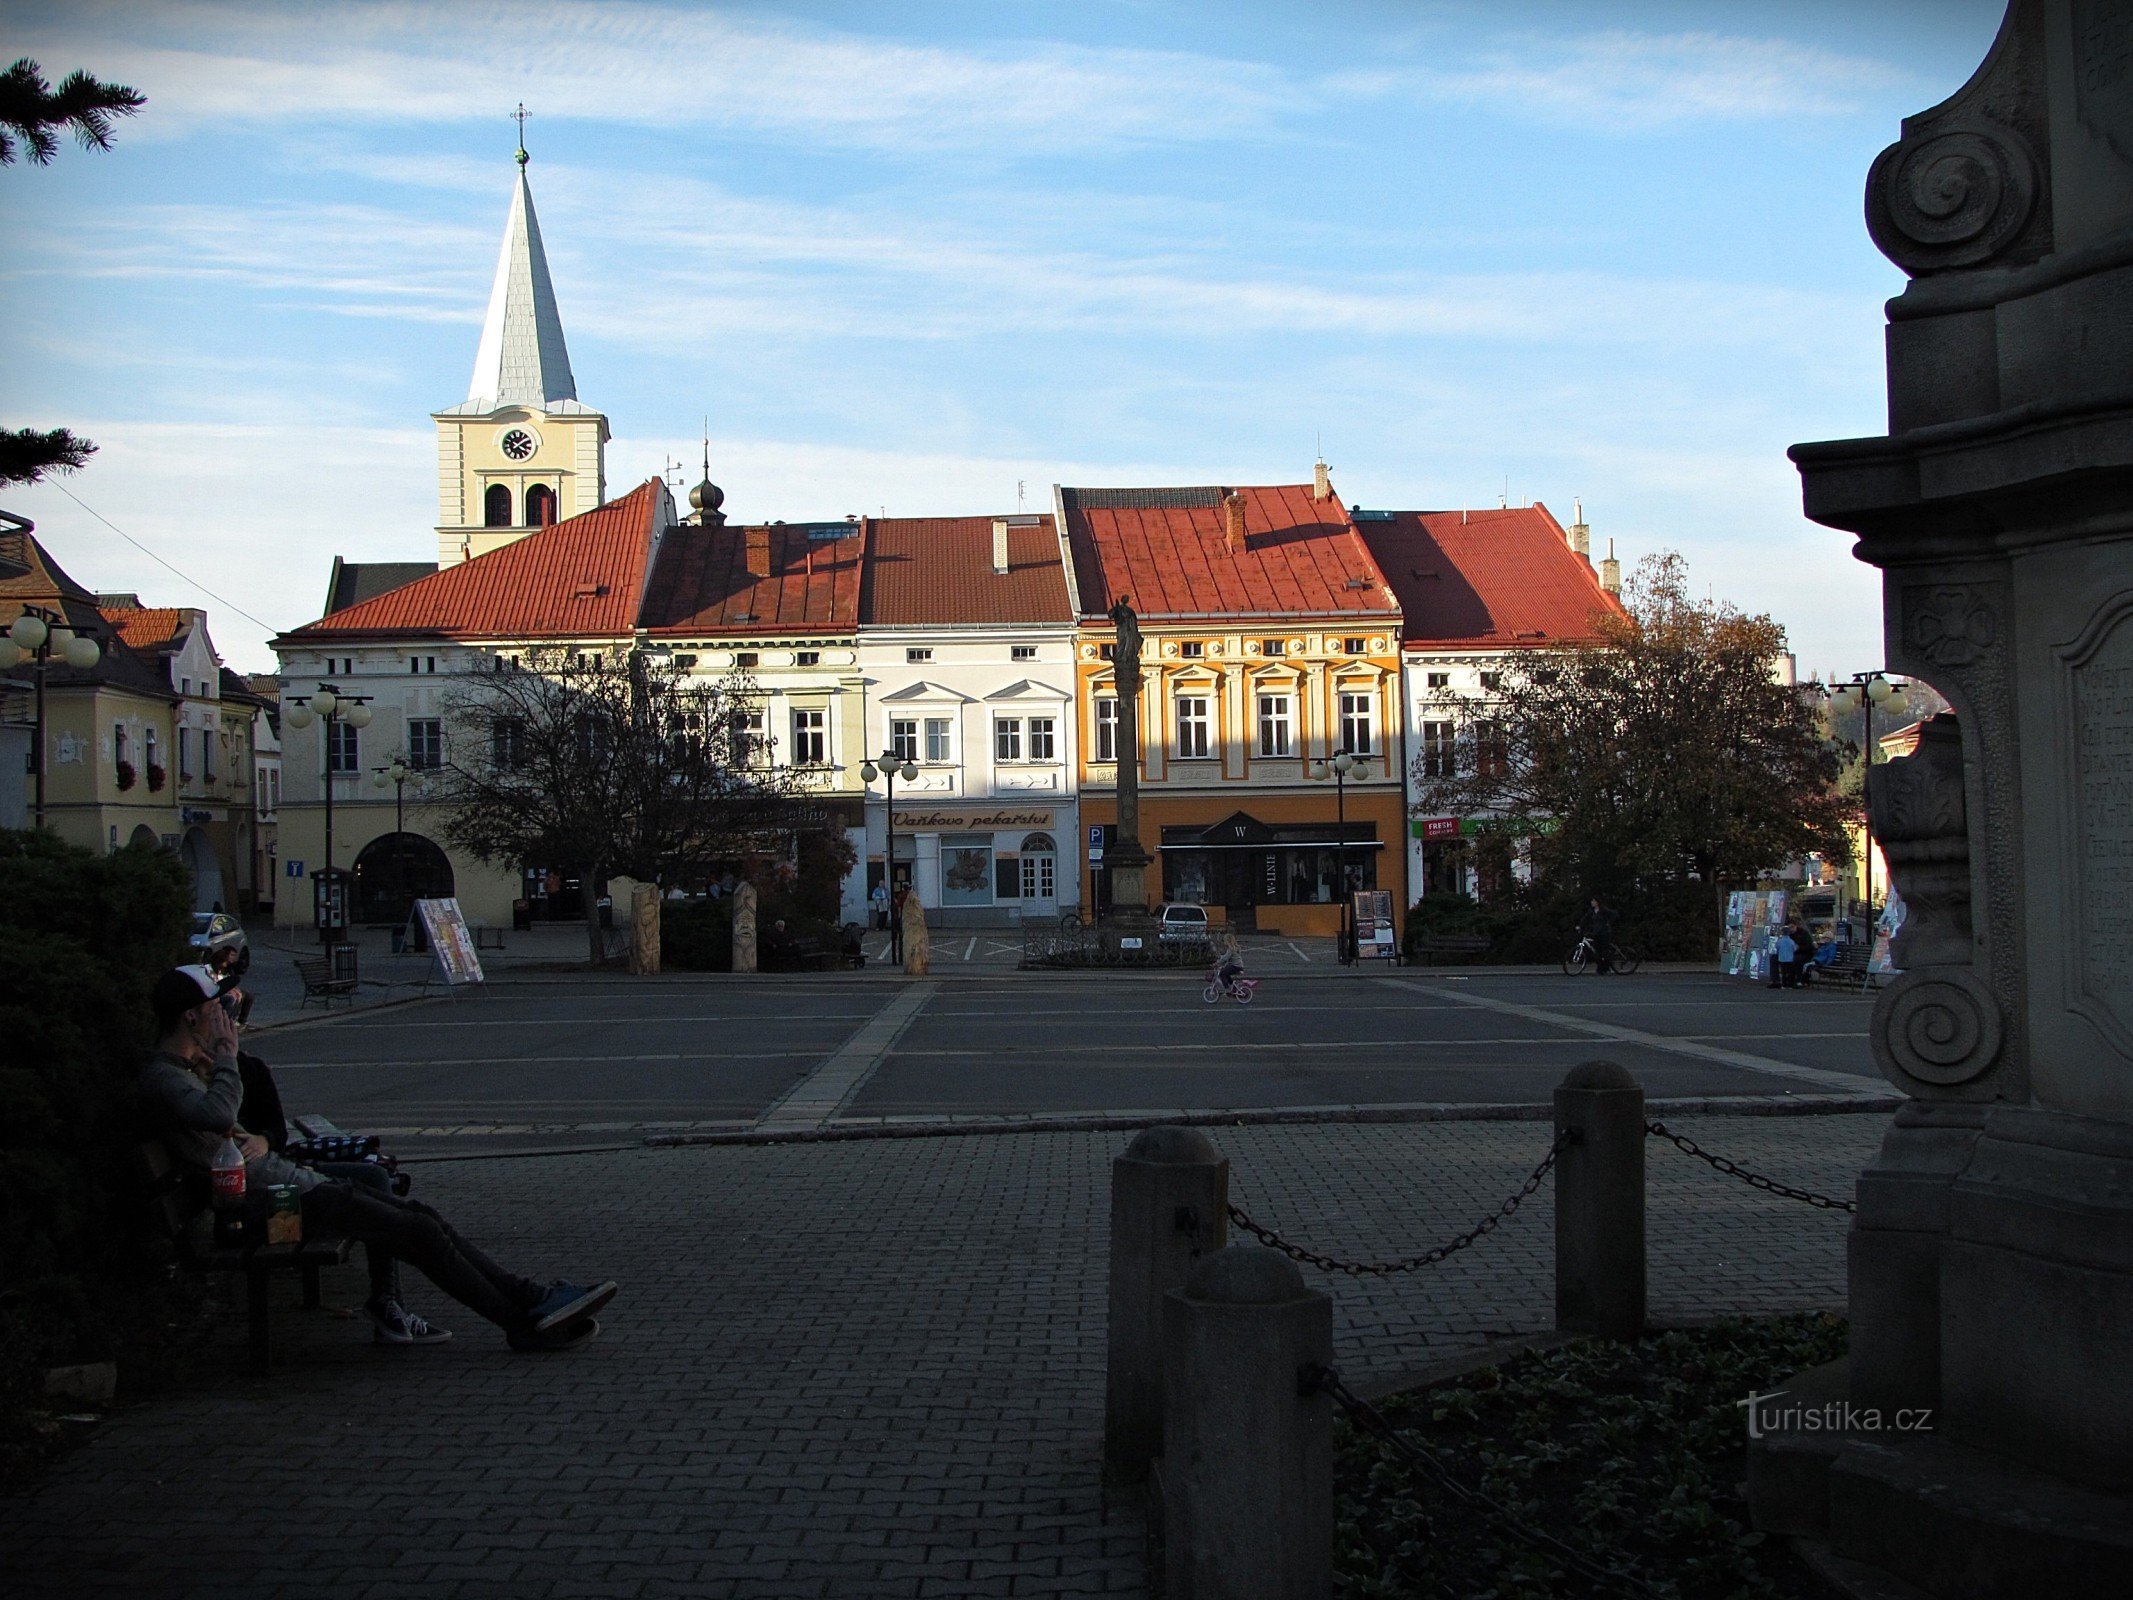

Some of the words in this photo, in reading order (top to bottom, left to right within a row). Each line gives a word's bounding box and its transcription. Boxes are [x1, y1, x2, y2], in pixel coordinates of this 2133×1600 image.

[892, 812, 964, 827] Vaňkovo
[1428, 821, 1453, 830] FRESH
[1091, 828, 1101, 842] P
[1234, 826, 1247, 838] W
